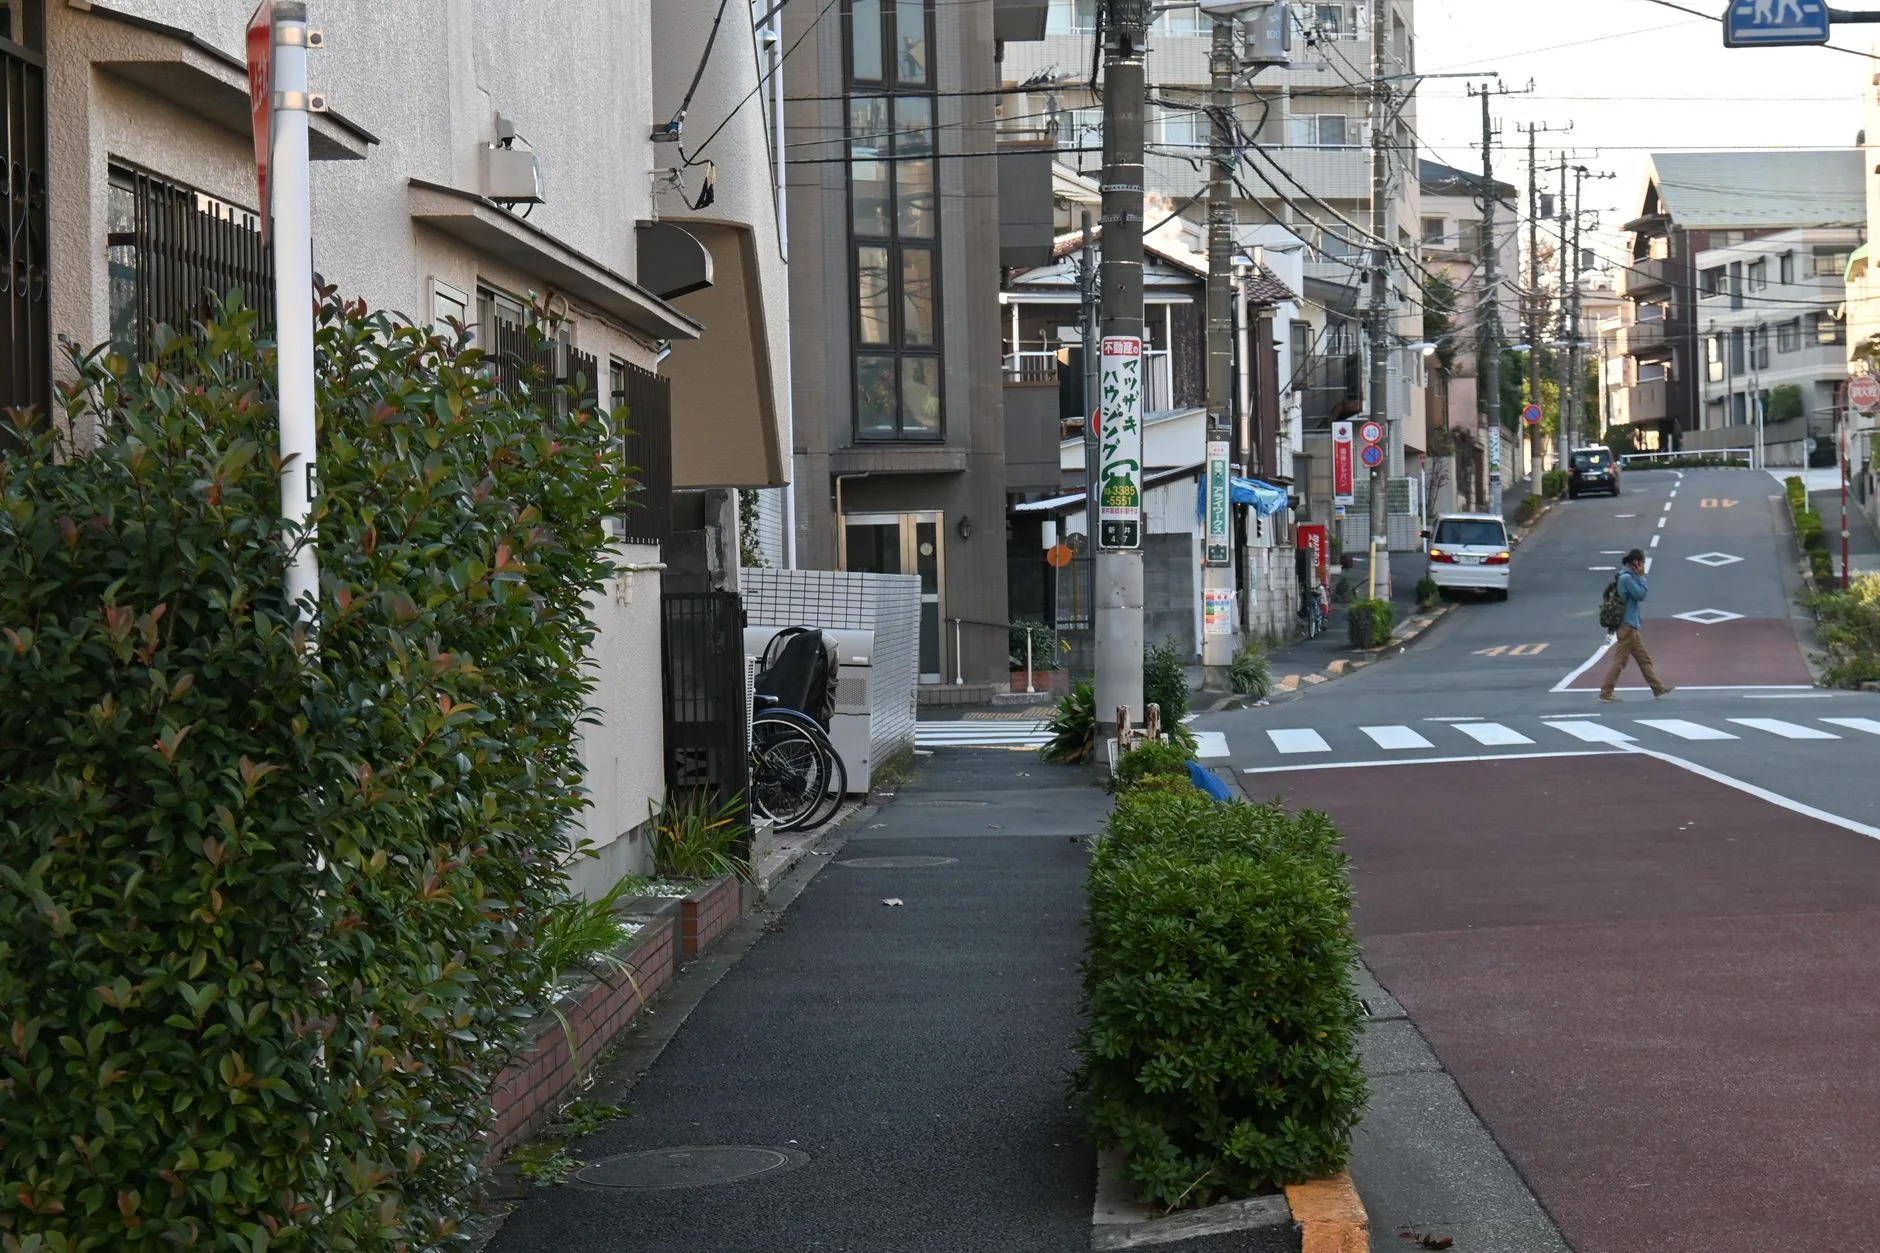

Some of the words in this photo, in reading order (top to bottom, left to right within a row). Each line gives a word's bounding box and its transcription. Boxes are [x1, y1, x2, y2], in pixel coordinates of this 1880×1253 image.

[1104, 341, 1138, 354] 不動産の
[1122, 359, 1139, 435] マツザキ
[1103, 370, 1122, 461] ハウジング
[1365, 428, 1377, 438] 40
[1103, 485, 1136, 496] 03-3385
[1470, 643, 1550, 657] 40
